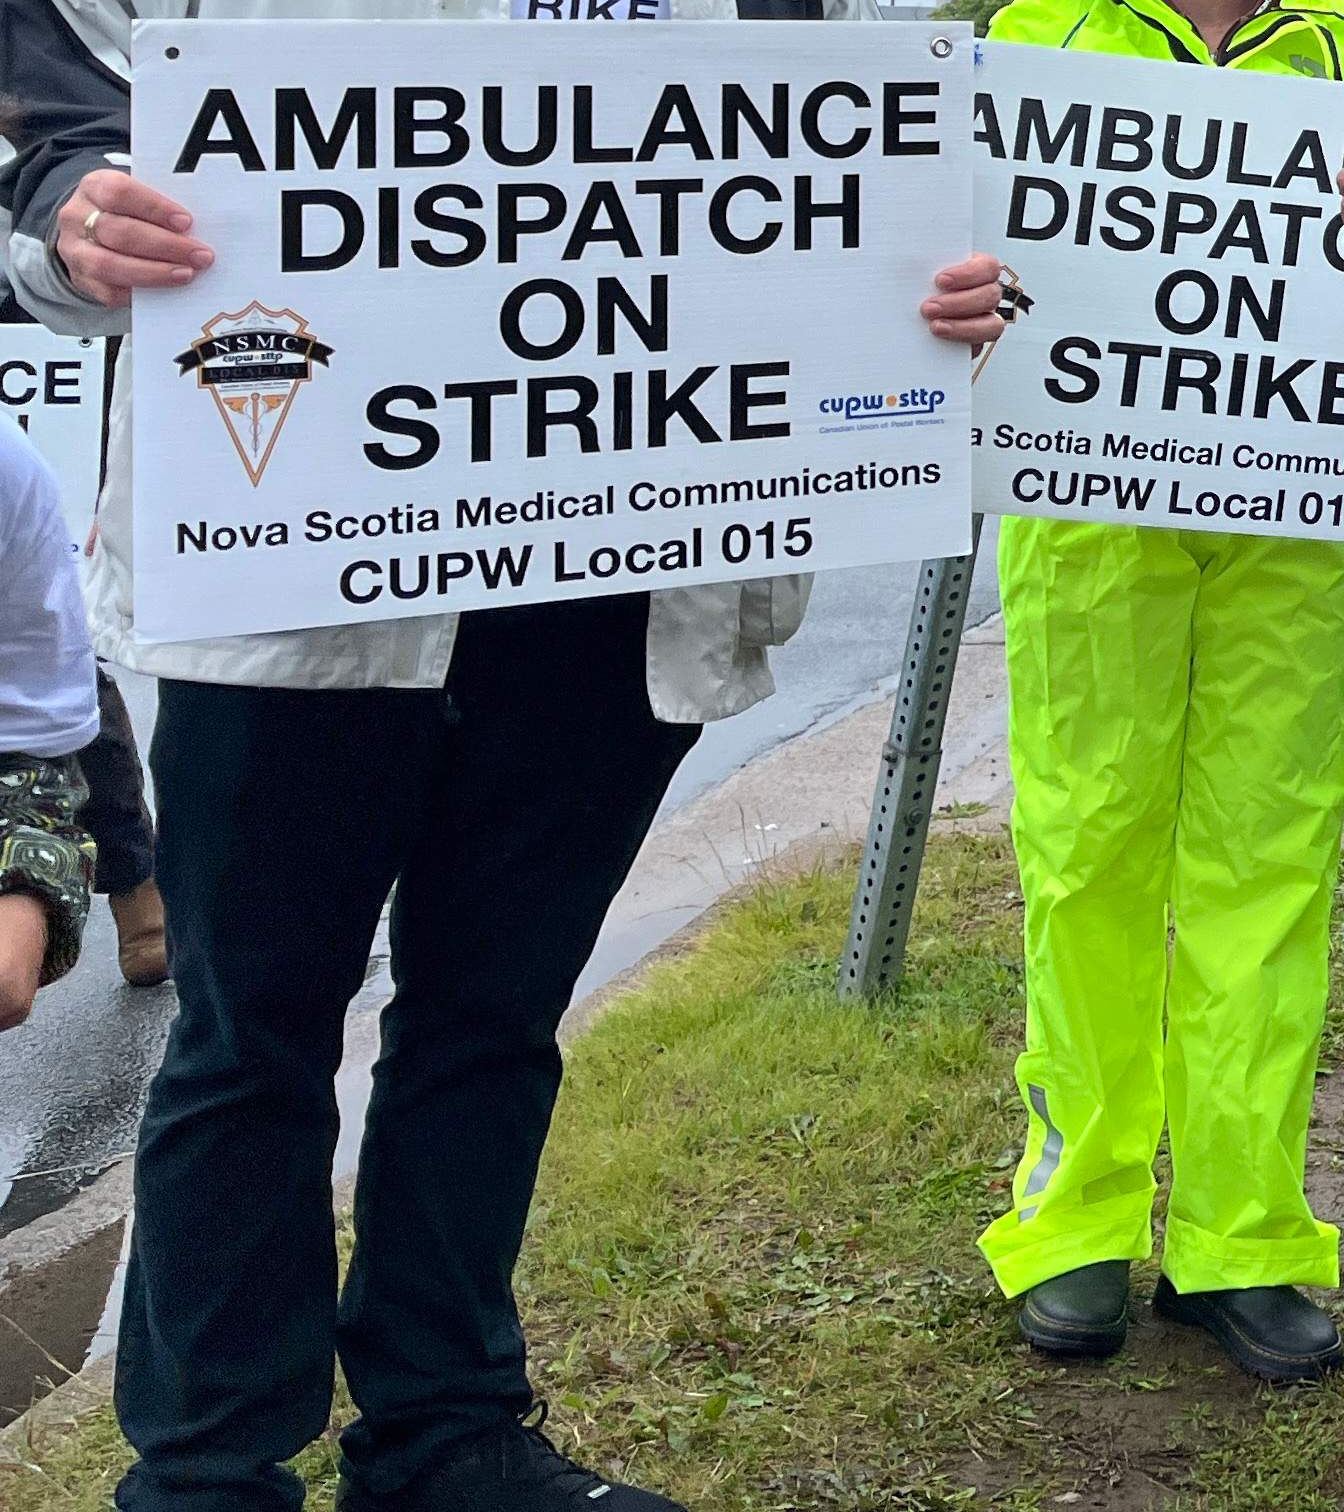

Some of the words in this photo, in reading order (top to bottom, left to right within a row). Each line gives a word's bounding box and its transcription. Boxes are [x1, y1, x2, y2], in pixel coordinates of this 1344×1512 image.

[172, 80, 941, 174] AMBULANCE
[281, 173, 860, 273] DISPATCH
[212, 335, 299, 355] NSMC
[499, 273, 669, 361] ON
[1154, 269, 1286, 343] ON
[362, 360, 791, 471] STRIKE
[993, 423, 1092, 456] Scotia
[1102, 433, 1223, 467] Medical
[177, 521, 289, 554] Nova
[304, 503, 440, 542] Scotia
[455, 485, 614, 529] Medical
[628, 461, 941, 512] Communications
[1011, 467, 1157, 511] CUPW
[1167, 480, 1286, 522] Local
[339, 544, 534, 605] CUPW
[554, 527, 702, 583] Local
[721, 517, 813, 564] 015
